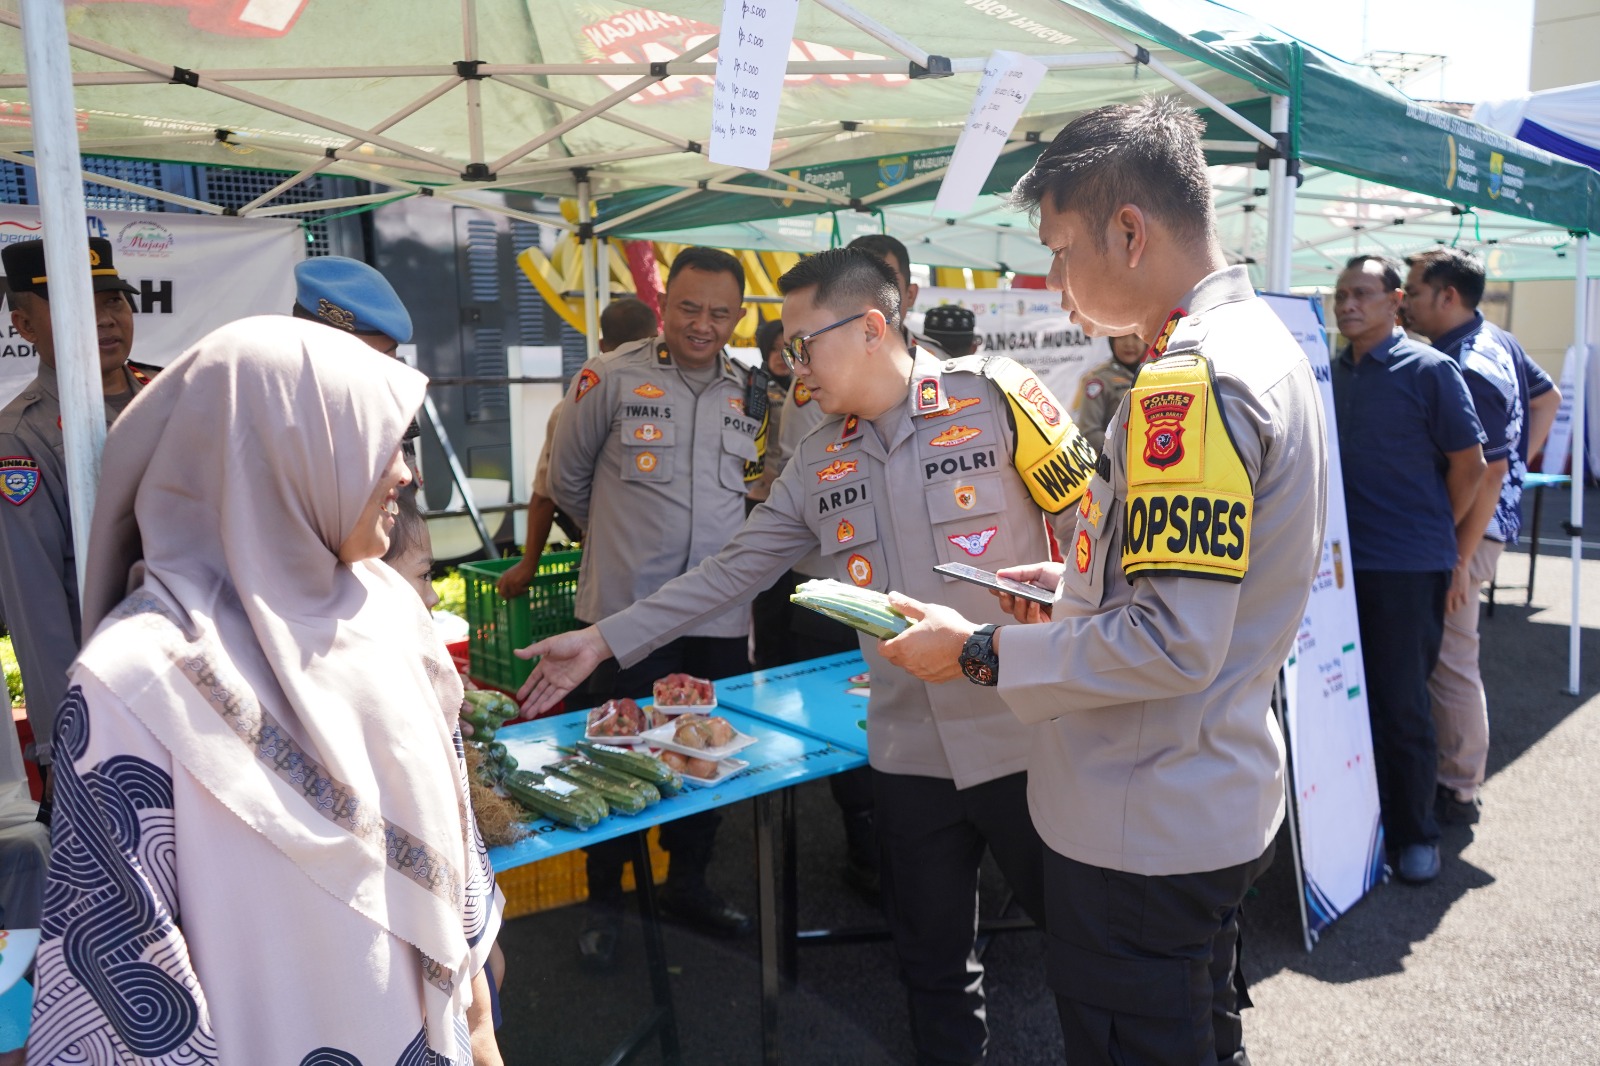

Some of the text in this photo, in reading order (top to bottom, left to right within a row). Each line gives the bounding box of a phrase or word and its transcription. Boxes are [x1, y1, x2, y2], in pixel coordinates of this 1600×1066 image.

[804, 170, 844, 186] Pangan
[1143, 393, 1190, 408] POLRES
[626, 405, 672, 419] IWAN.S
[925, 450, 996, 479] POLRI
[819, 484, 867, 514] ARDI
